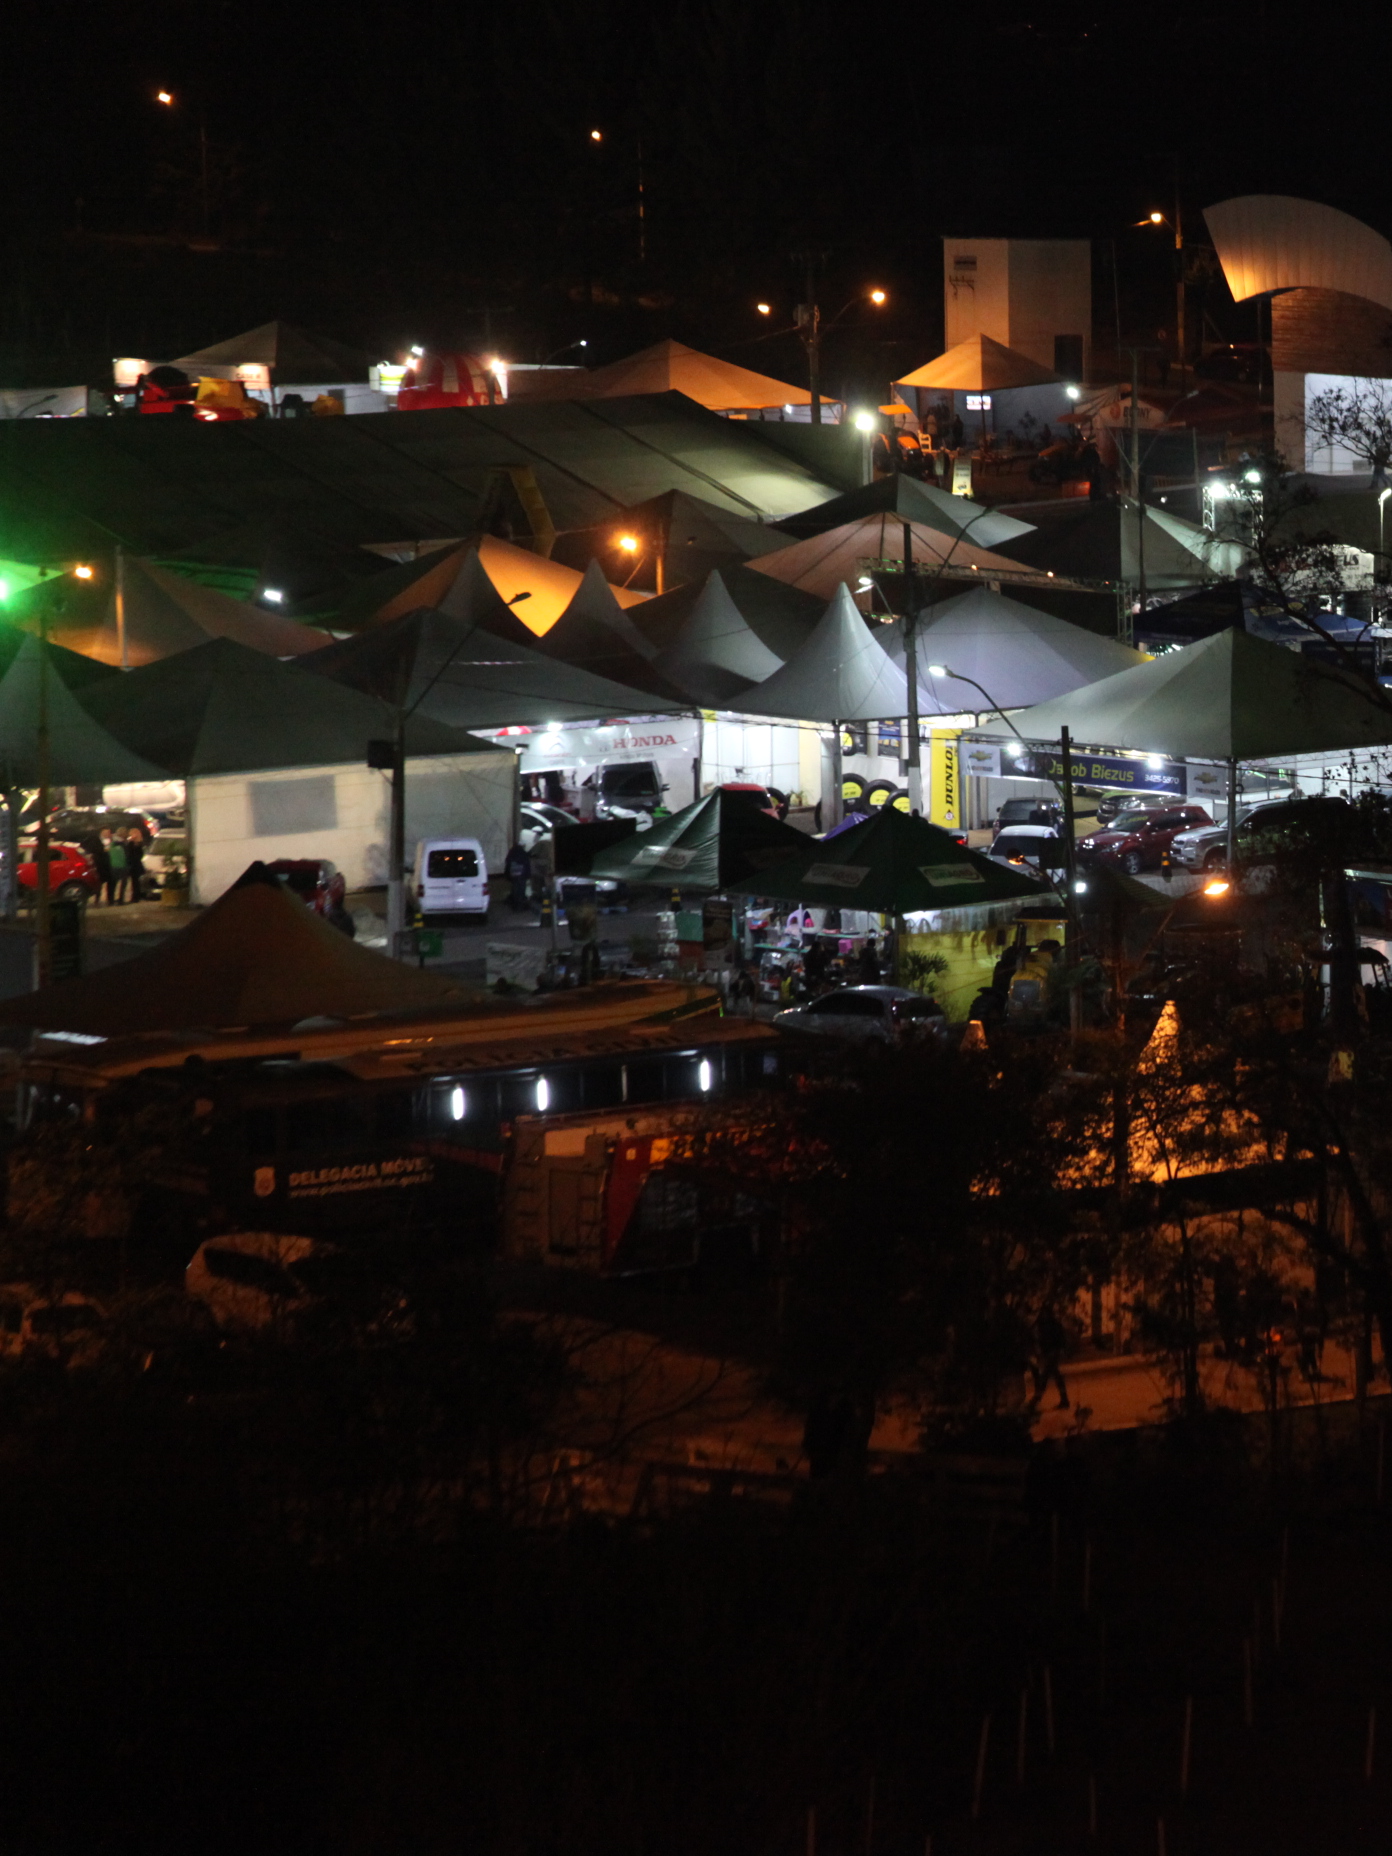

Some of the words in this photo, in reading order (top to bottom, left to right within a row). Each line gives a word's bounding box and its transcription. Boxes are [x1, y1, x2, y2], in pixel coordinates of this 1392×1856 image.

[613, 734, 677, 749] HONDA
[1048, 758, 1087, 777] Jaob
[288, 1163, 379, 1187] DELEGACIA
[380, 1157, 435, 1175] MÓVE
